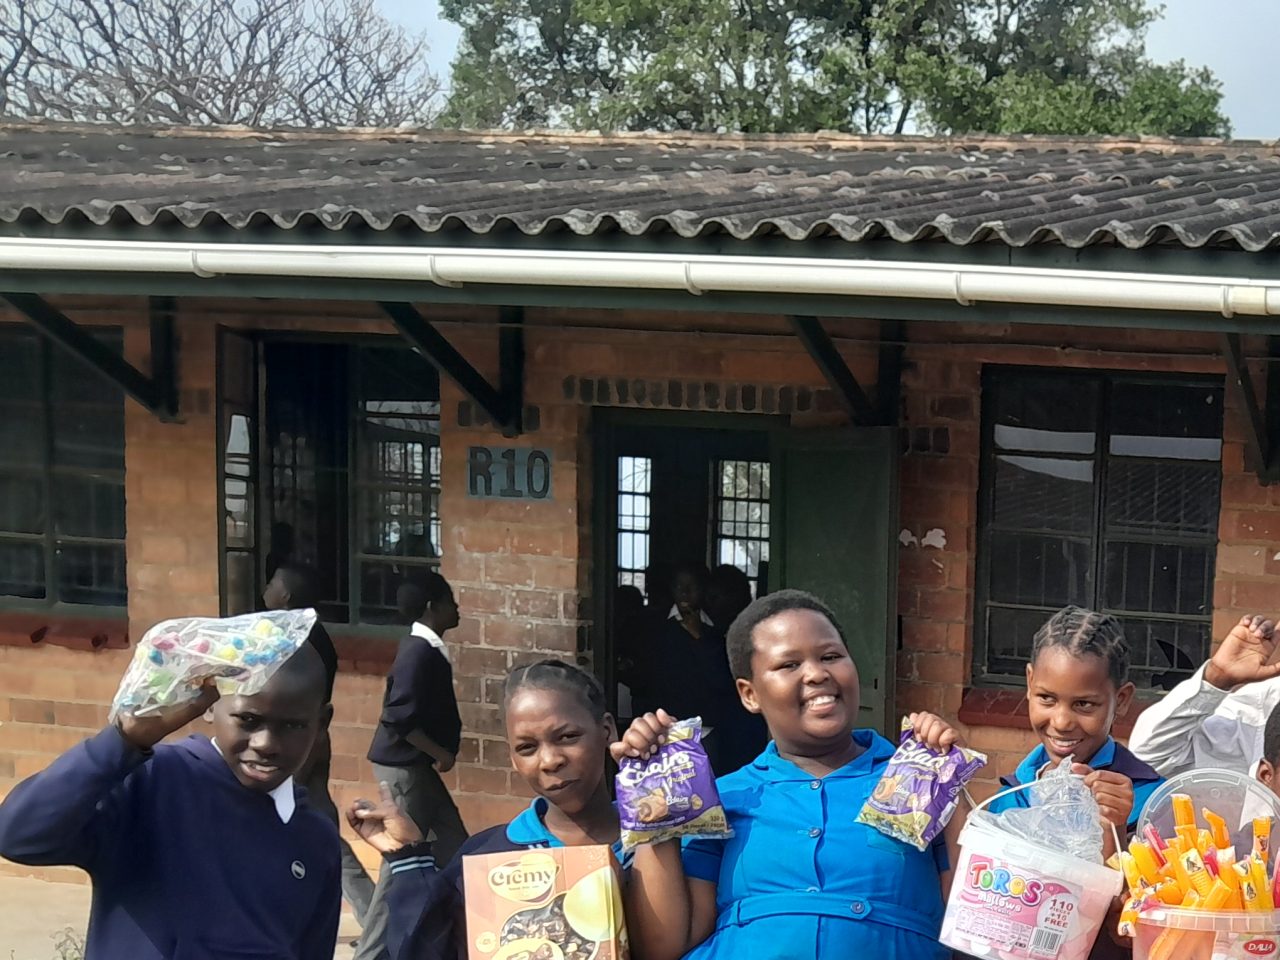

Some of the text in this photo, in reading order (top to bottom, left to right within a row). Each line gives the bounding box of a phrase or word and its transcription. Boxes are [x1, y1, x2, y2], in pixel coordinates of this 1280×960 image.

[468, 446, 550, 499] R10
[970, 862, 1043, 906] TOROS
[1051, 898, 1074, 912] 110
[1044, 916, 1069, 929] FREE
